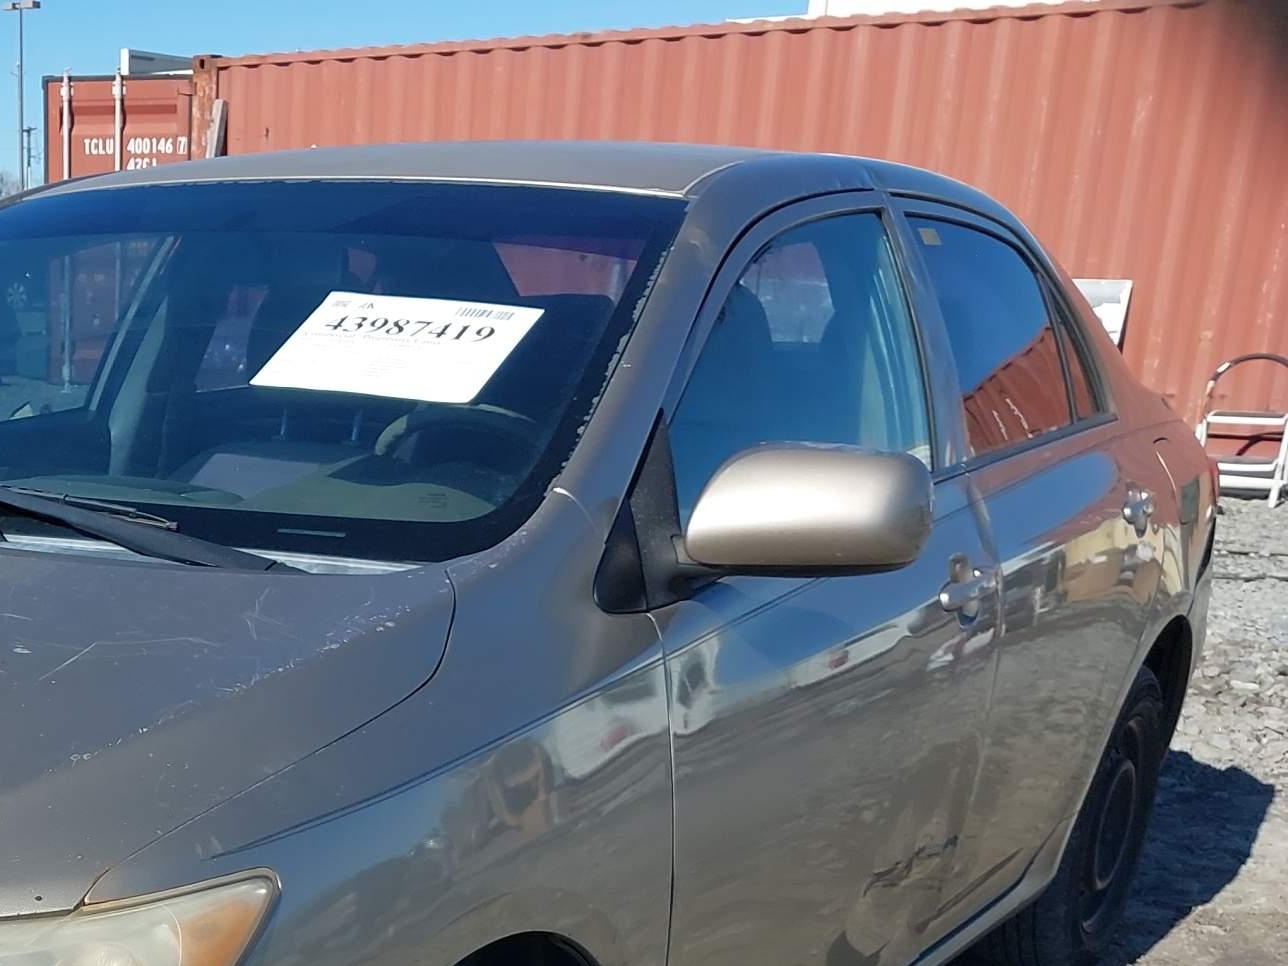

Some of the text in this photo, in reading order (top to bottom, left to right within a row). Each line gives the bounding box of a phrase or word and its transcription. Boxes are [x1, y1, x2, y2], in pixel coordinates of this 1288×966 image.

[83, 137, 188, 155] TCLU 400146 7
[324, 314, 496, 343] 43987419
